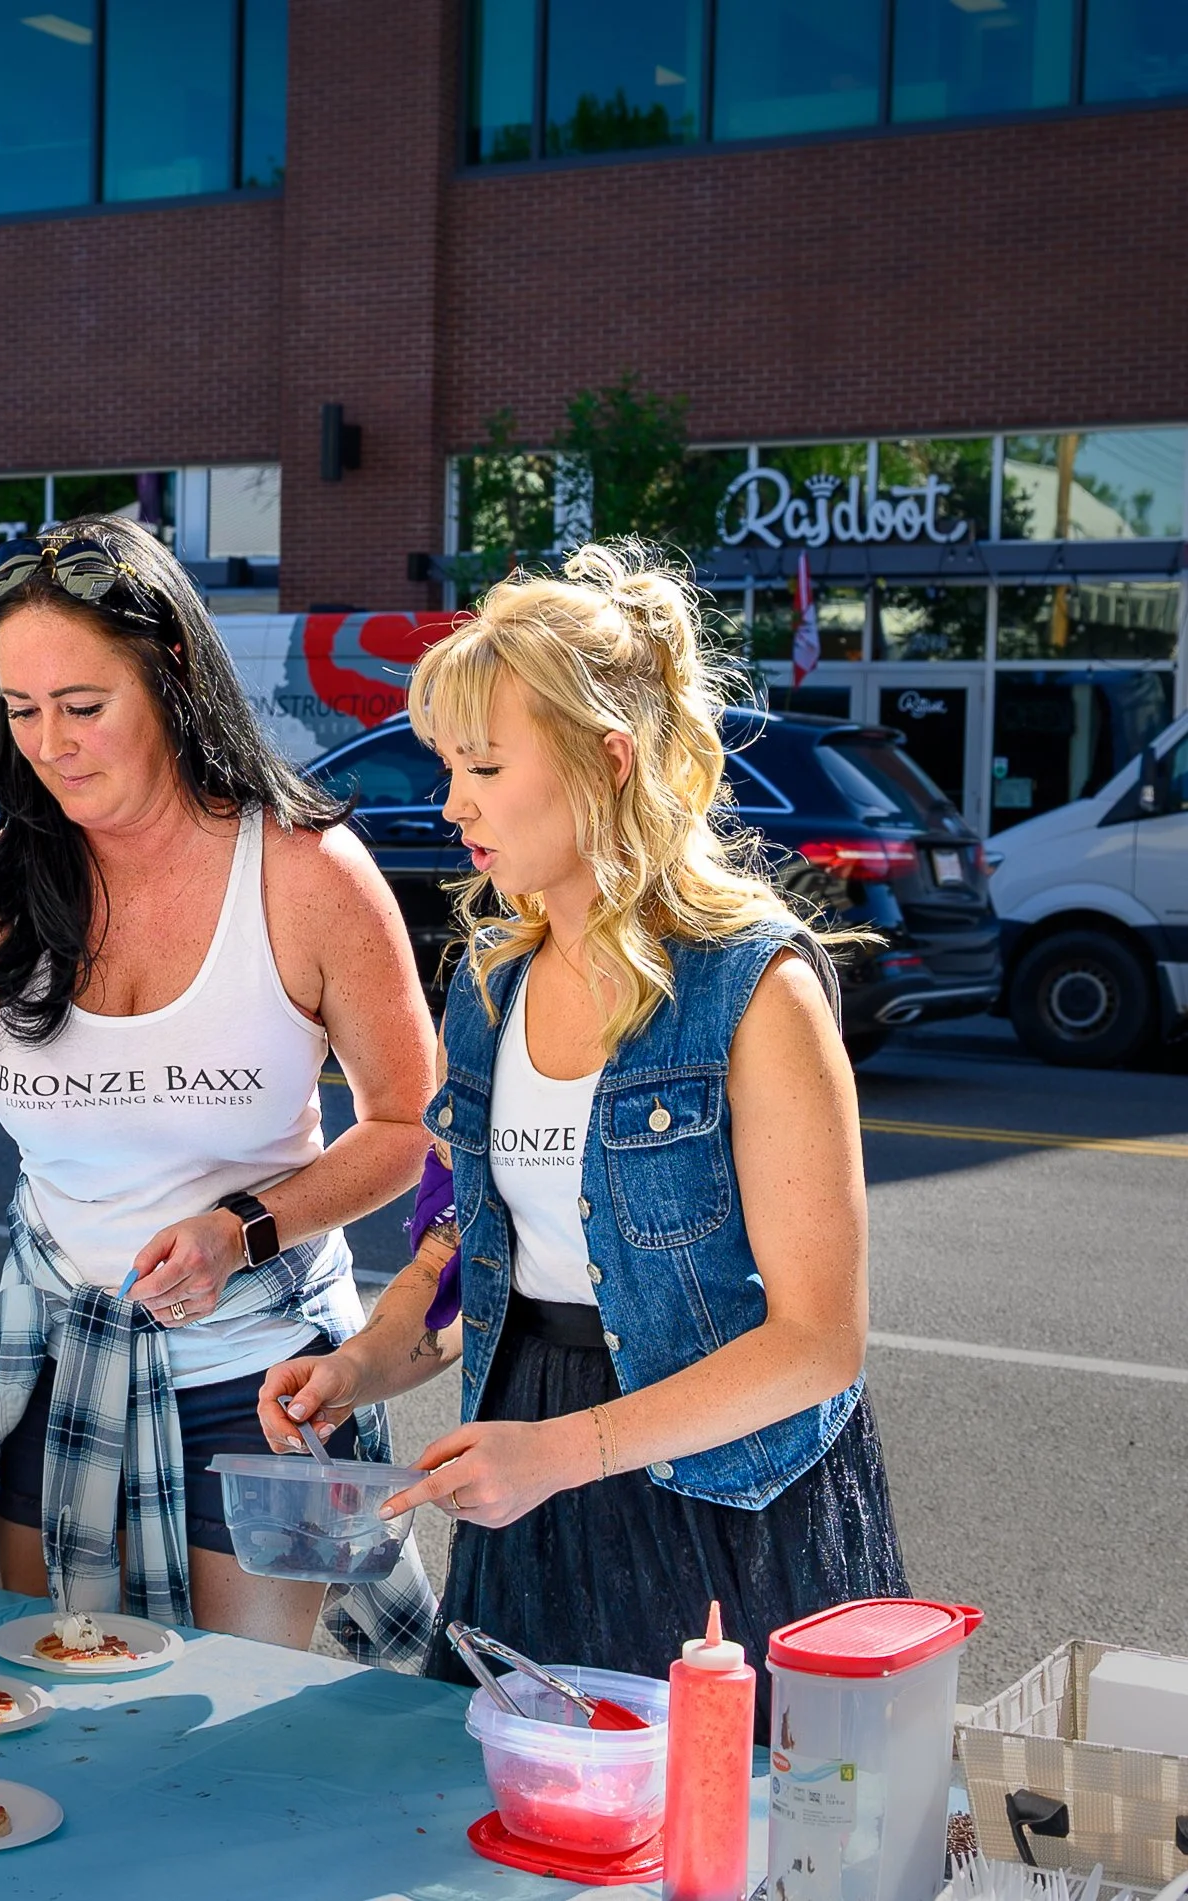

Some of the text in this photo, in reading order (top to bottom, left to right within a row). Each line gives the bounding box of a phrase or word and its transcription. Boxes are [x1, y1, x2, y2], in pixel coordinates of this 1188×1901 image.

[248, 694, 409, 718] ONSTRUCTION
[163, 1065, 266, 1092] BAXX
[6, 1095, 253, 1110] LUXURY TANNING & WELLNESS
[492, 1127, 576, 1153] RONZE
[518, 1156, 575, 1167] TANNING
